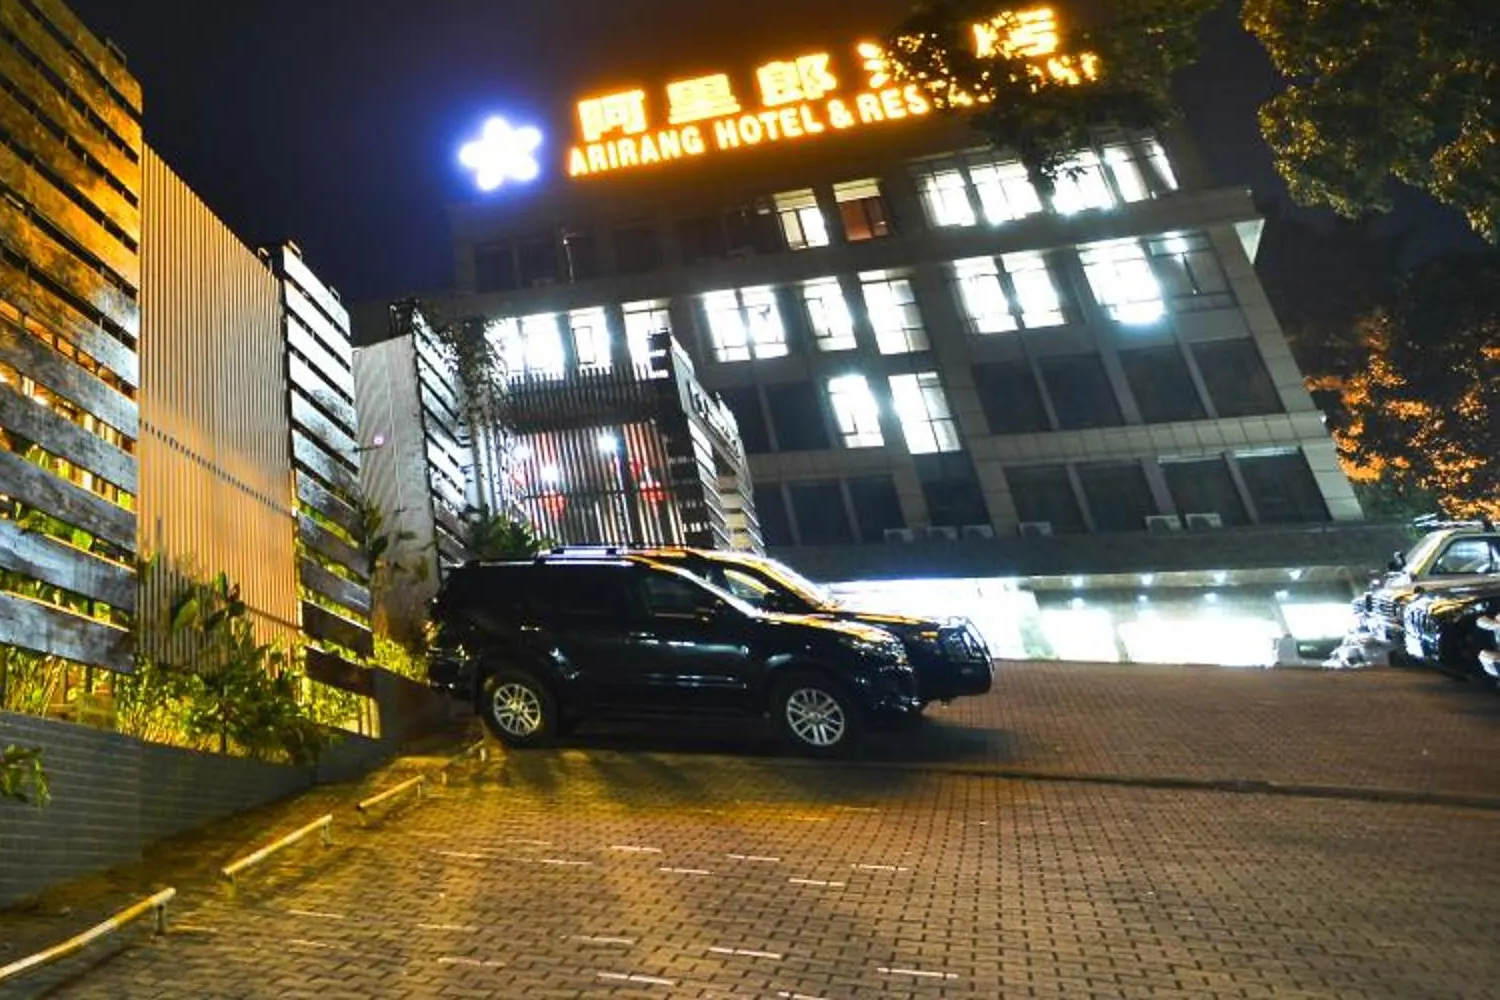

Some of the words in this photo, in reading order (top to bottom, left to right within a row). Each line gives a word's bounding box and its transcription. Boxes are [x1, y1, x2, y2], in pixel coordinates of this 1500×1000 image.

[569, 126, 705, 177] ARIRANG
[714, 105, 824, 150] HOTEL
[827, 100, 854, 128] &
